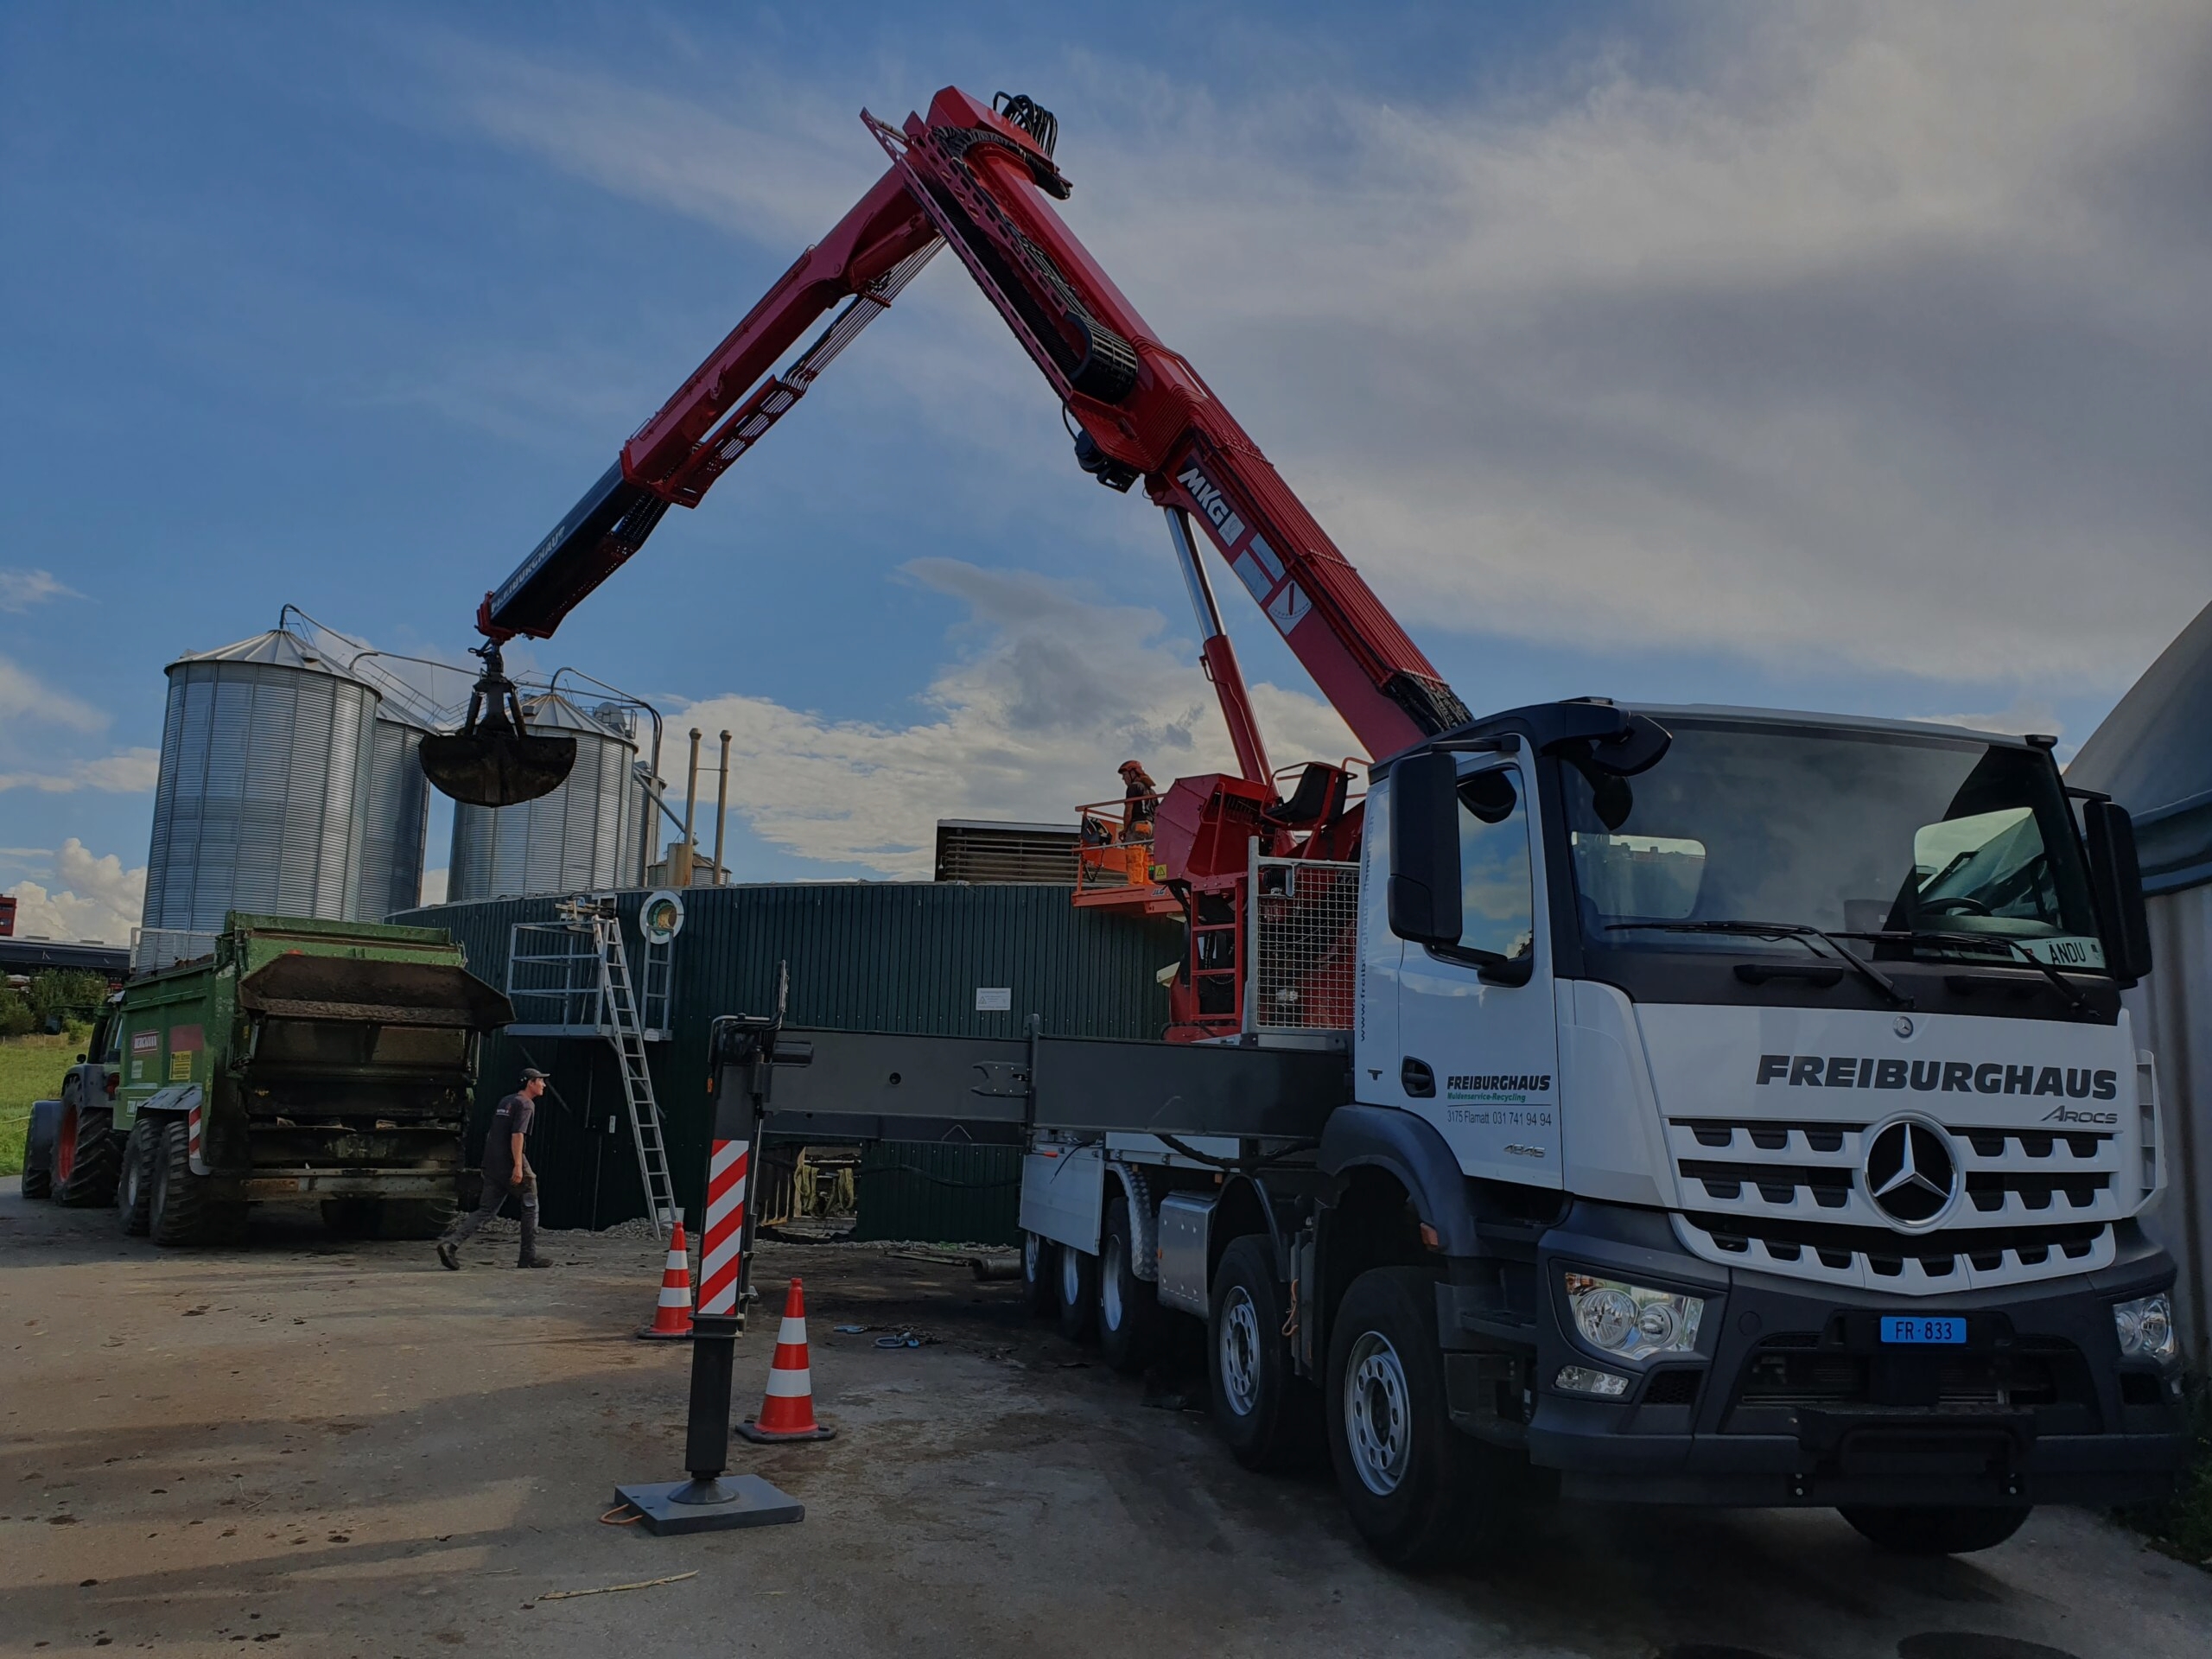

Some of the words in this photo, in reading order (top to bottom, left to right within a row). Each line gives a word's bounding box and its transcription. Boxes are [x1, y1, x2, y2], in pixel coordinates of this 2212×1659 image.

[1176, 467, 1229, 526] MKG
[2046, 941, 2086, 963] ÄNDU
[1447, 1075, 1551, 1090] FREIBURGHAUS
[1756, 1055, 2117, 1100] FREIBURGHAUS
[1447, 1092, 1526, 1103] Muldenservice-Recycling
[1447, 1110, 1463, 1122] 3175
[1465, 1110, 1489, 1123] Flamatt
[1493, 1111, 1506, 1124] 031
[1509, 1112, 1523, 1125] 741
[1526, 1112, 1537, 1126] 94
[1540, 1113, 1552, 1126] 94
